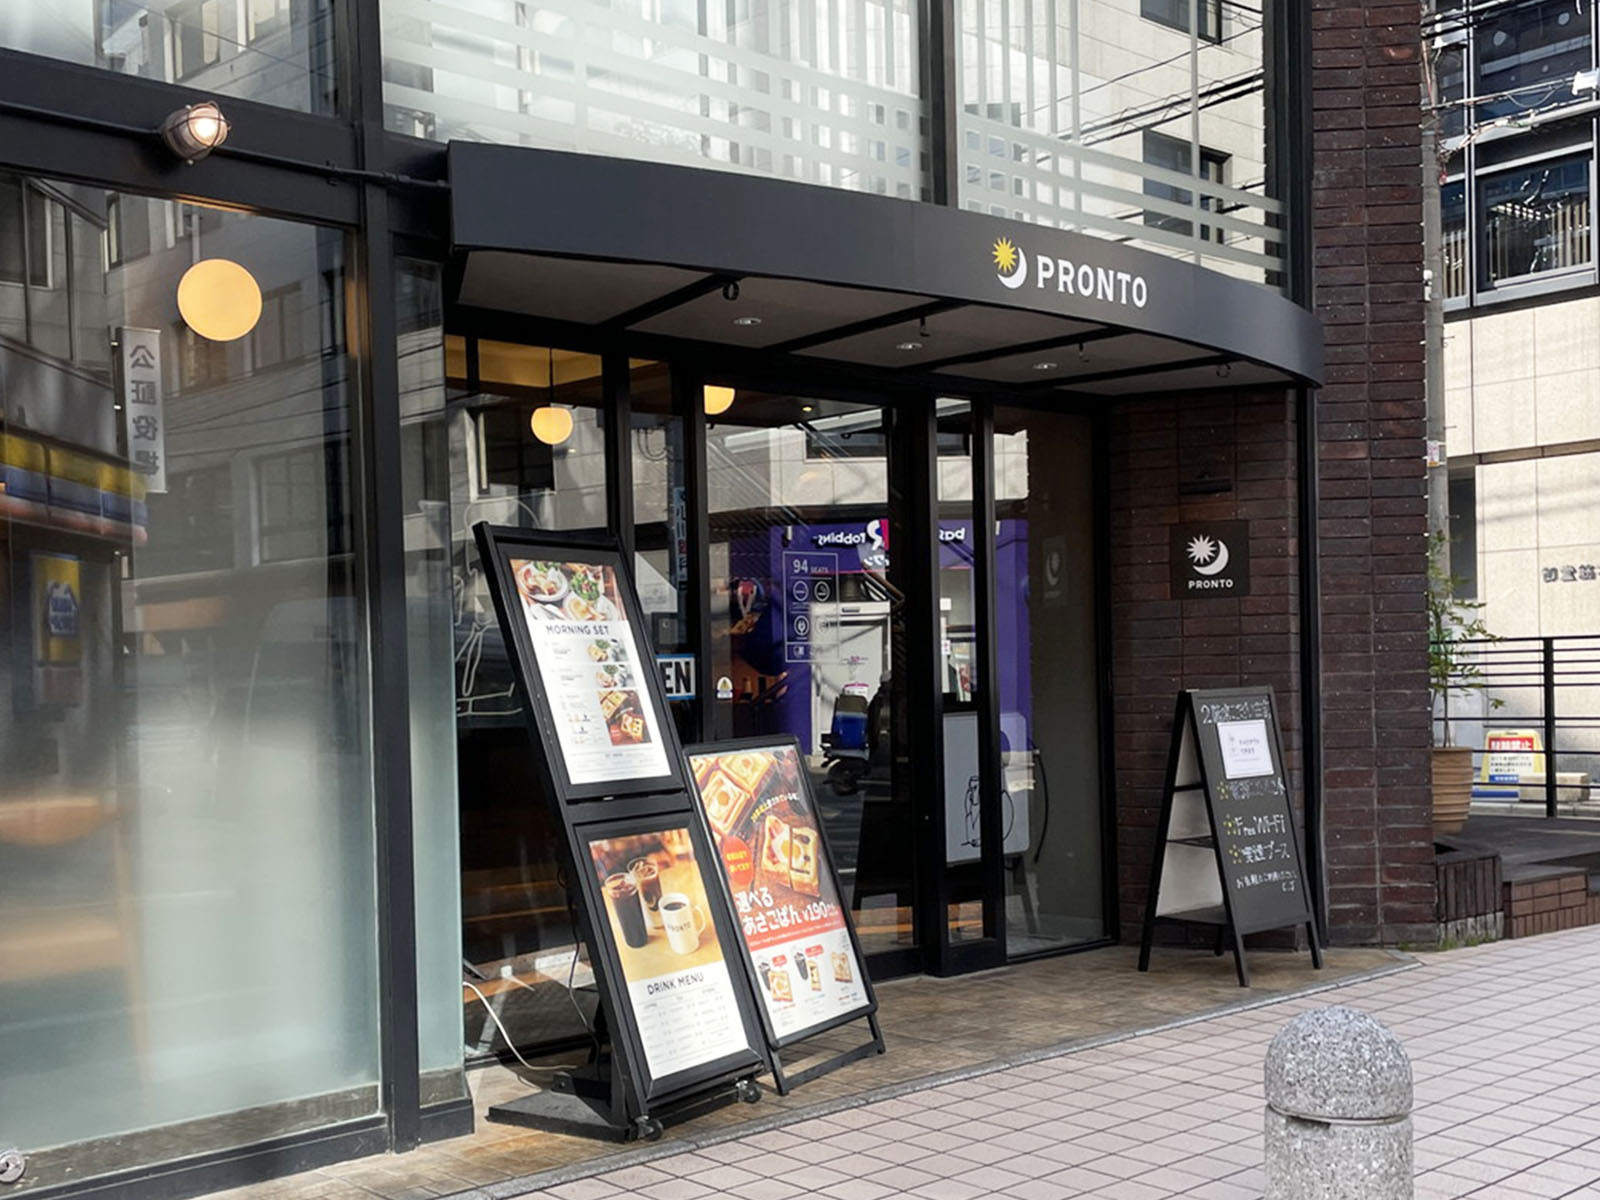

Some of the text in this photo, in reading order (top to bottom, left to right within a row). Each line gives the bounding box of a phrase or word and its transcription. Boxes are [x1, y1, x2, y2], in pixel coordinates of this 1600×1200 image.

[1036, 254, 1149, 309] PRONTO
[792, 558, 809, 574] 94
[1187, 579, 1234, 590] PRONTO
[545, 624, 610, 636] MORNING SET
[646, 971, 705, 996] DRINK MENU
